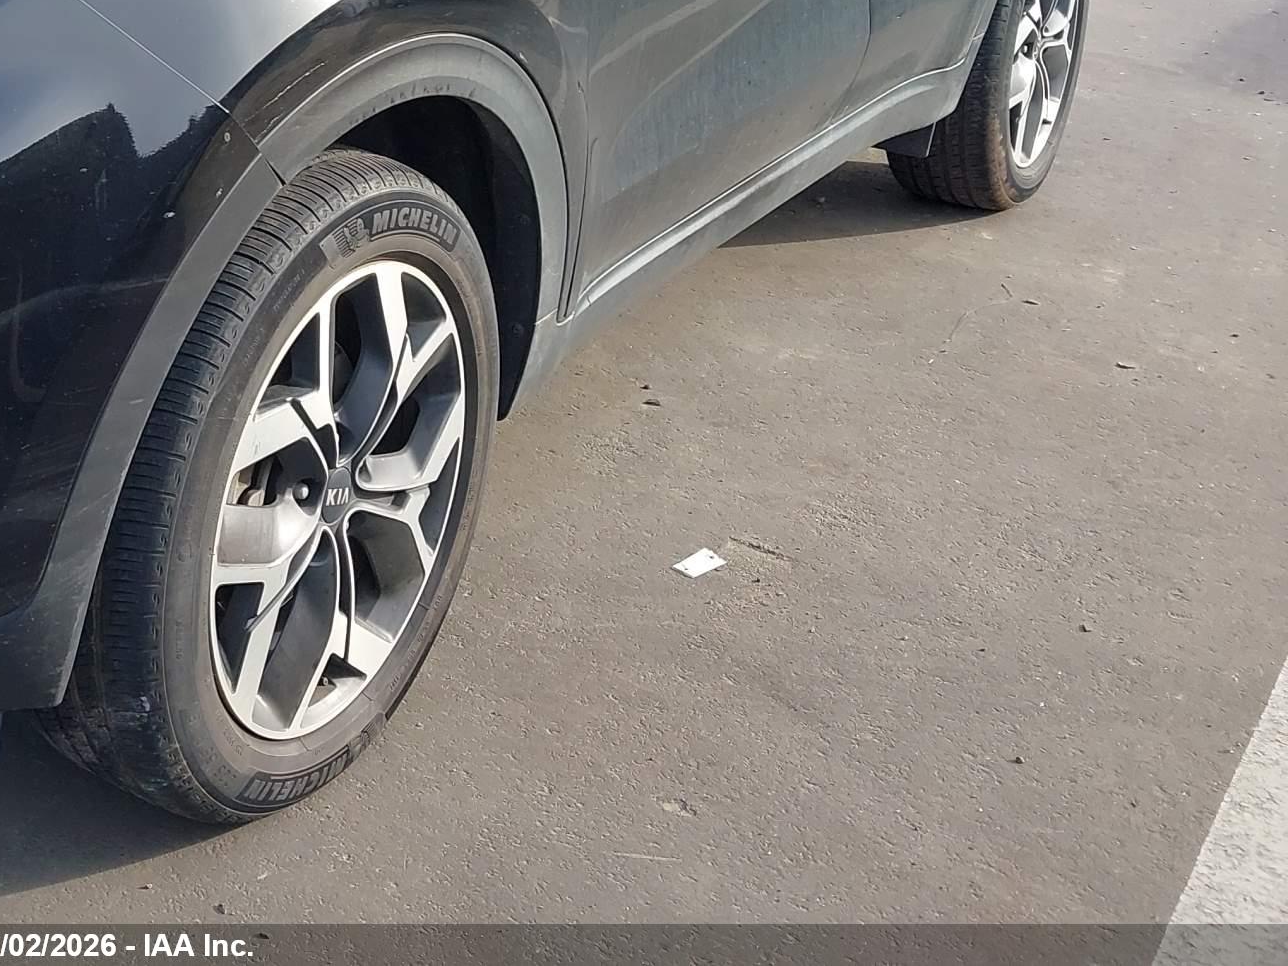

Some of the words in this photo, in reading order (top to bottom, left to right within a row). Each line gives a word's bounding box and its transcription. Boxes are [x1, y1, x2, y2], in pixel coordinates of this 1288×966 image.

[371, 207, 458, 246] MICHELIN
[325, 487, 349, 506] KIA
[244, 751, 350, 802] MICHELIN
